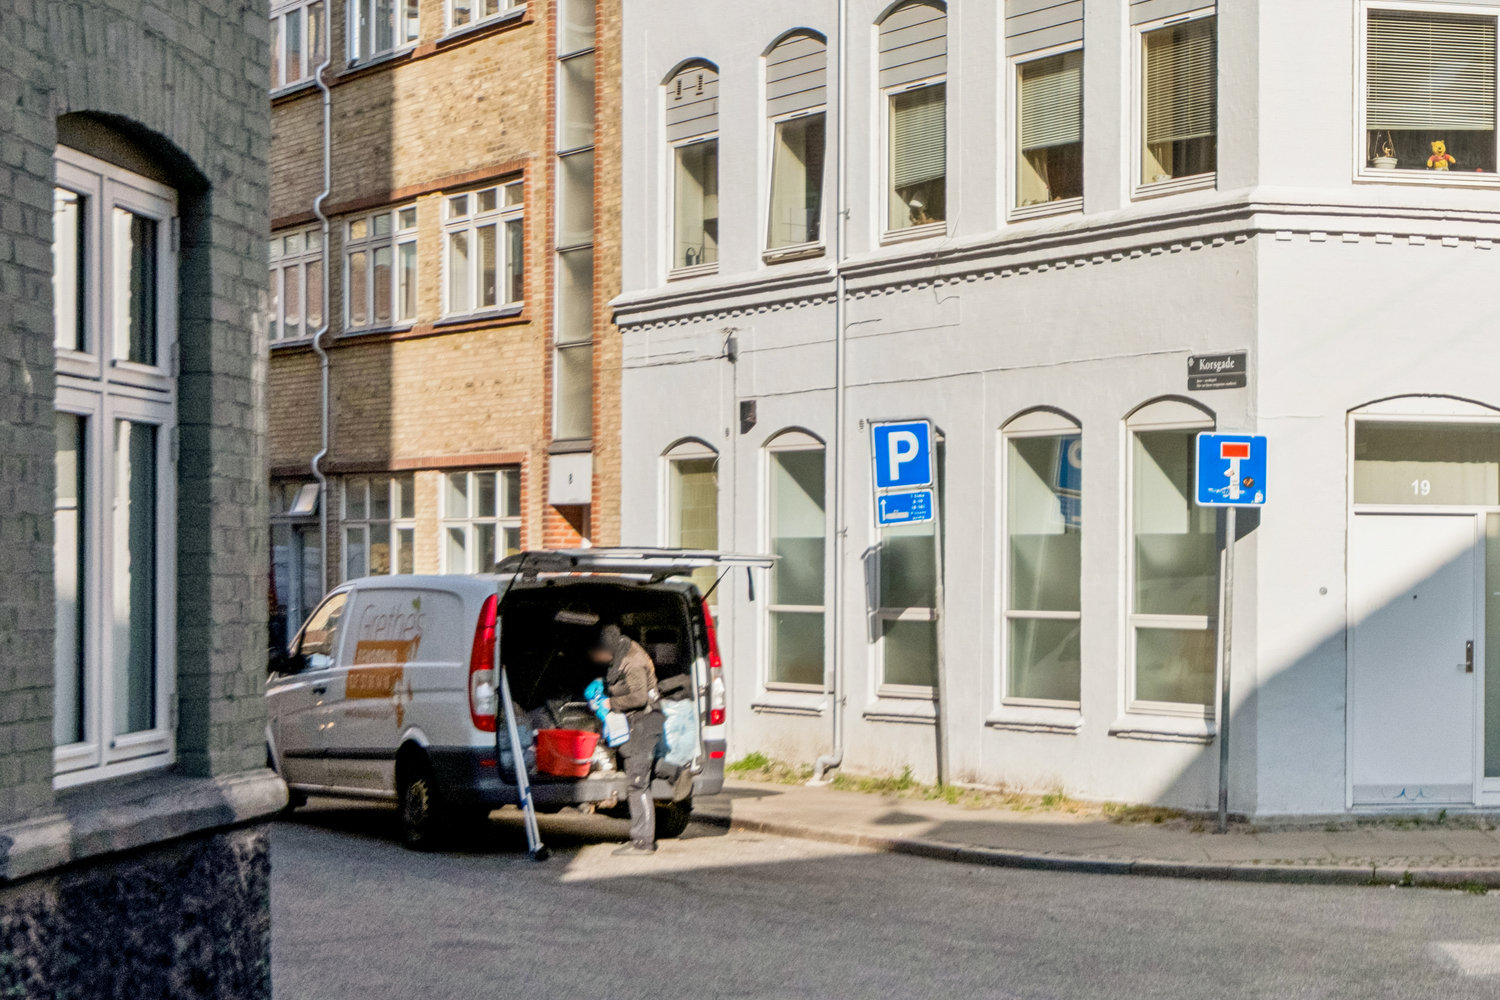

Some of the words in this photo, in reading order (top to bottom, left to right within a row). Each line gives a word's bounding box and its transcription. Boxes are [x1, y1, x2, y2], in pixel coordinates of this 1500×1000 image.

[1199, 357, 1235, 372] Korsgade
[888, 430, 920, 481] P
[1411, 479, 1431, 496] 19
